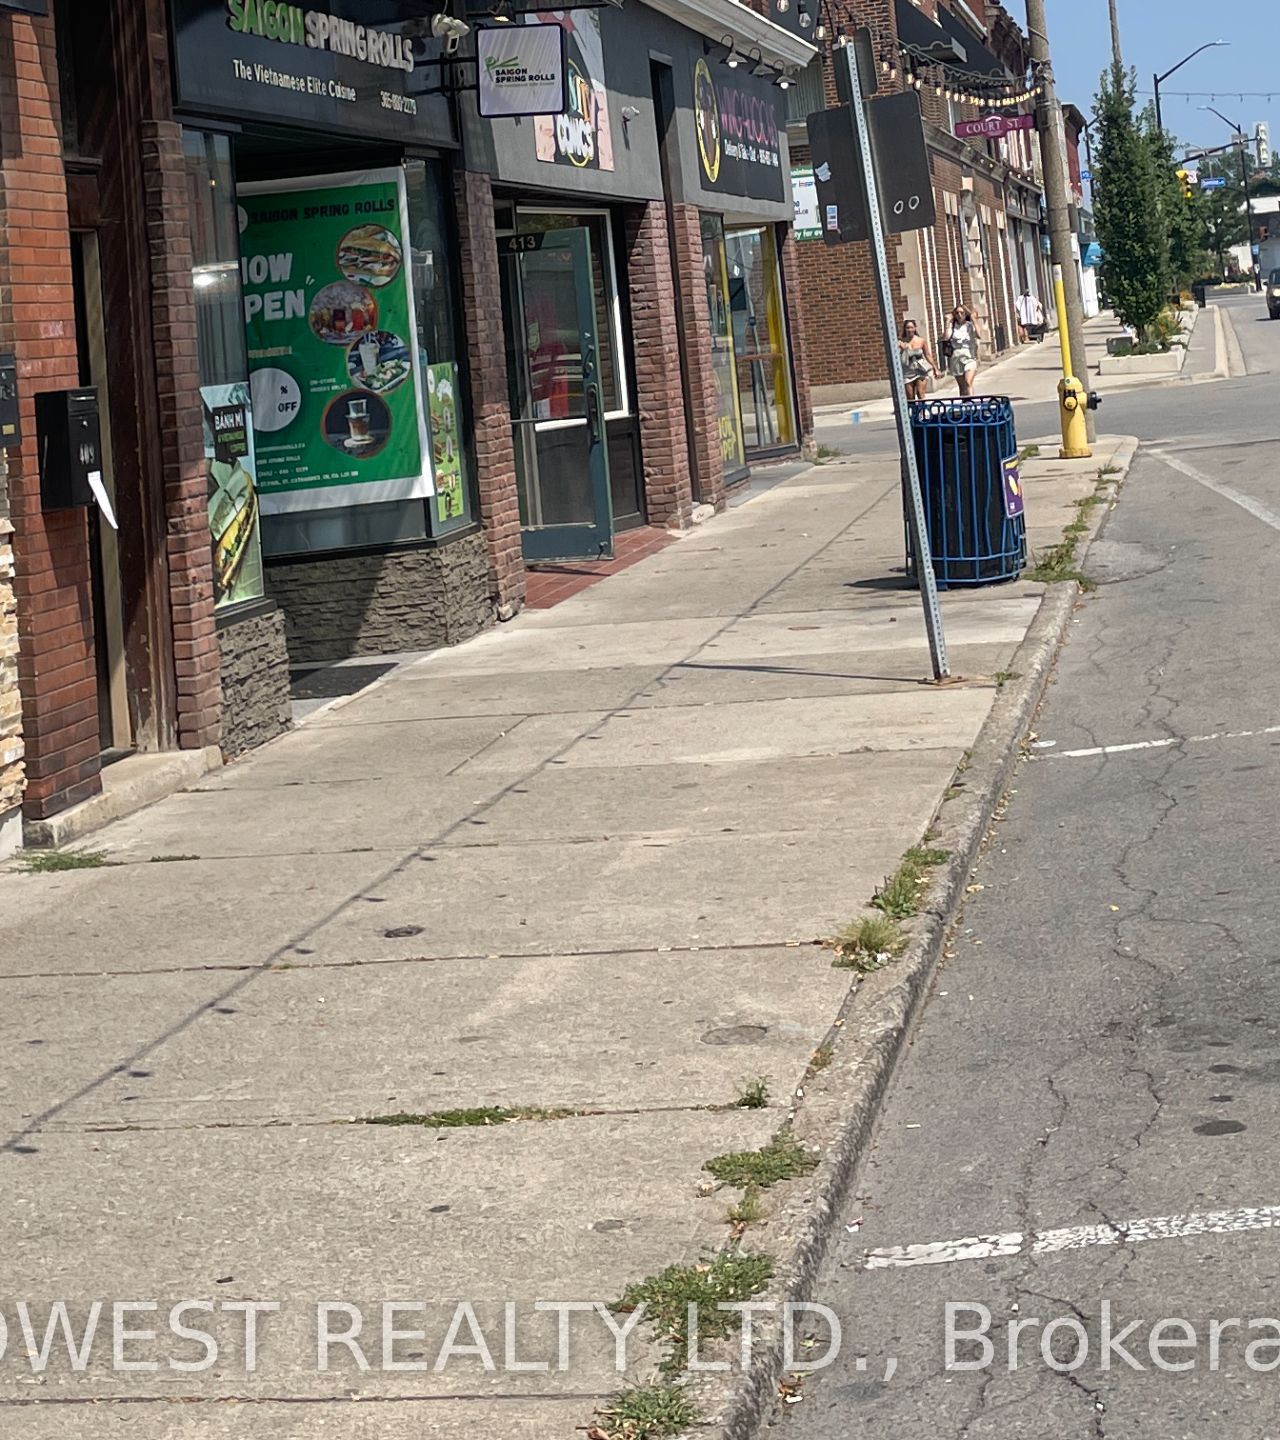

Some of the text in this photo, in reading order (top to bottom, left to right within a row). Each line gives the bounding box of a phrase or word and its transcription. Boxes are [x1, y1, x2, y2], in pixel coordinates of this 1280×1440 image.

[495, 68, 527, 76] SAIGON
[495, 73, 555, 84] SPRING ROLLS
[233, 59, 357, 101] The Vietnamese Elite Cuisine
[966, 118, 1023, 134] COURT ST.
[251, 198, 395, 224] SAIGON SPRING ROLLS
[508, 235, 536, 250] 413
[244, 288, 305, 323] PEN
[277, 401, 298, 413] OFF
